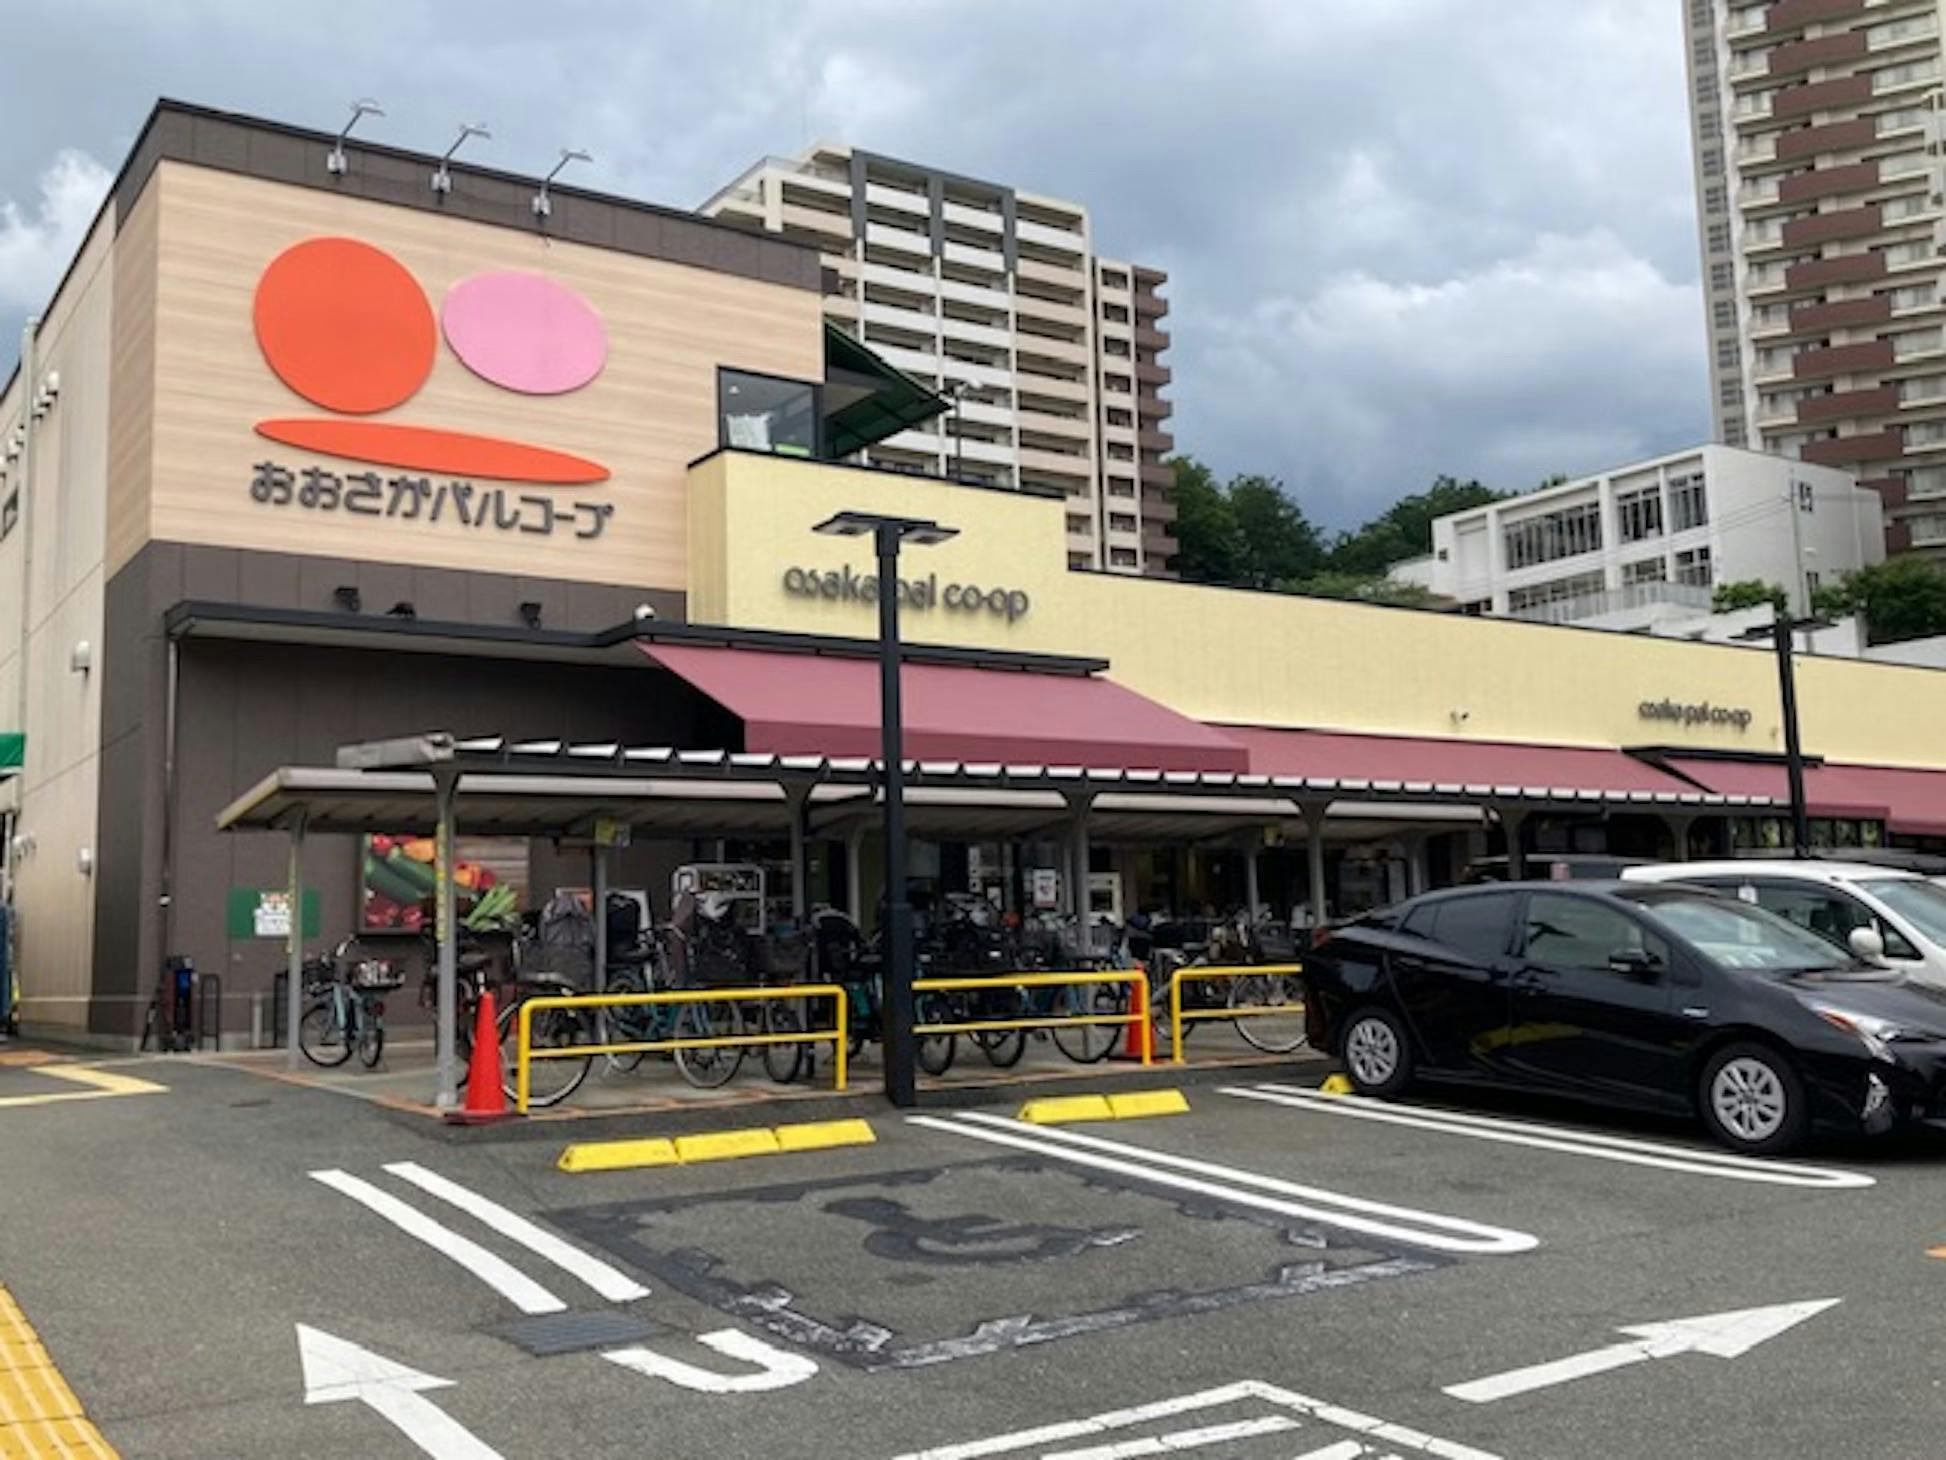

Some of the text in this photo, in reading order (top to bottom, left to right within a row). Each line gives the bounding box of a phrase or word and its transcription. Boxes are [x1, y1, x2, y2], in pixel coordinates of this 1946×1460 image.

[250, 460, 614, 539] おおさかパルコープ
[783, 563, 881, 602] osaka
[943, 582, 1029, 626] co-op
